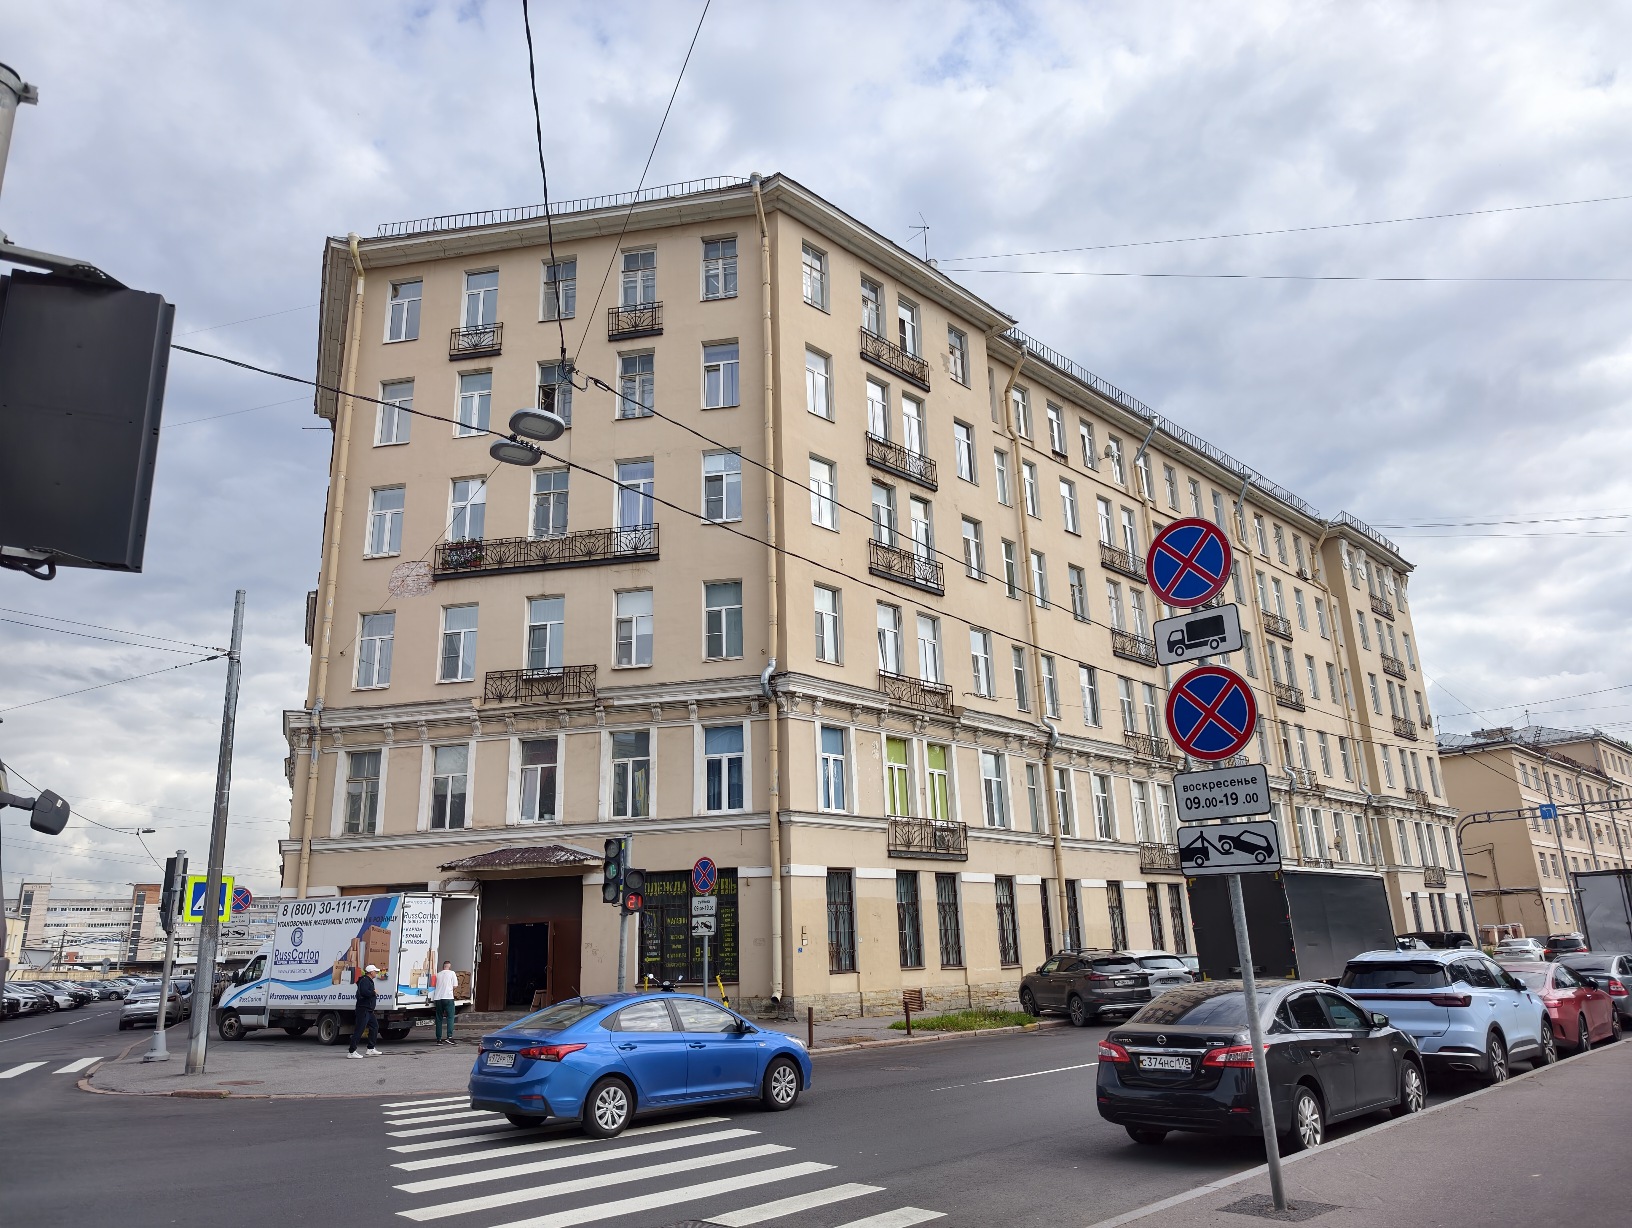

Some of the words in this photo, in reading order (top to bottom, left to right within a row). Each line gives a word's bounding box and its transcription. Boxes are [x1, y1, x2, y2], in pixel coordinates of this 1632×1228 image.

[1183, 776, 1257, 792] воскресенье
[628, 895, 642, 908] 21
[282, 904, 288, 916] 8
[291, 903, 316, 918] (800)
[318, 900, 370, 915] 30-111-77
[274, 948, 320, 960] RussCarton
[269, 992, 299, 1000] Изготовим
[300, 993, 328, 1002] упаковку
[338, 992, 357, 1000] Ваши
